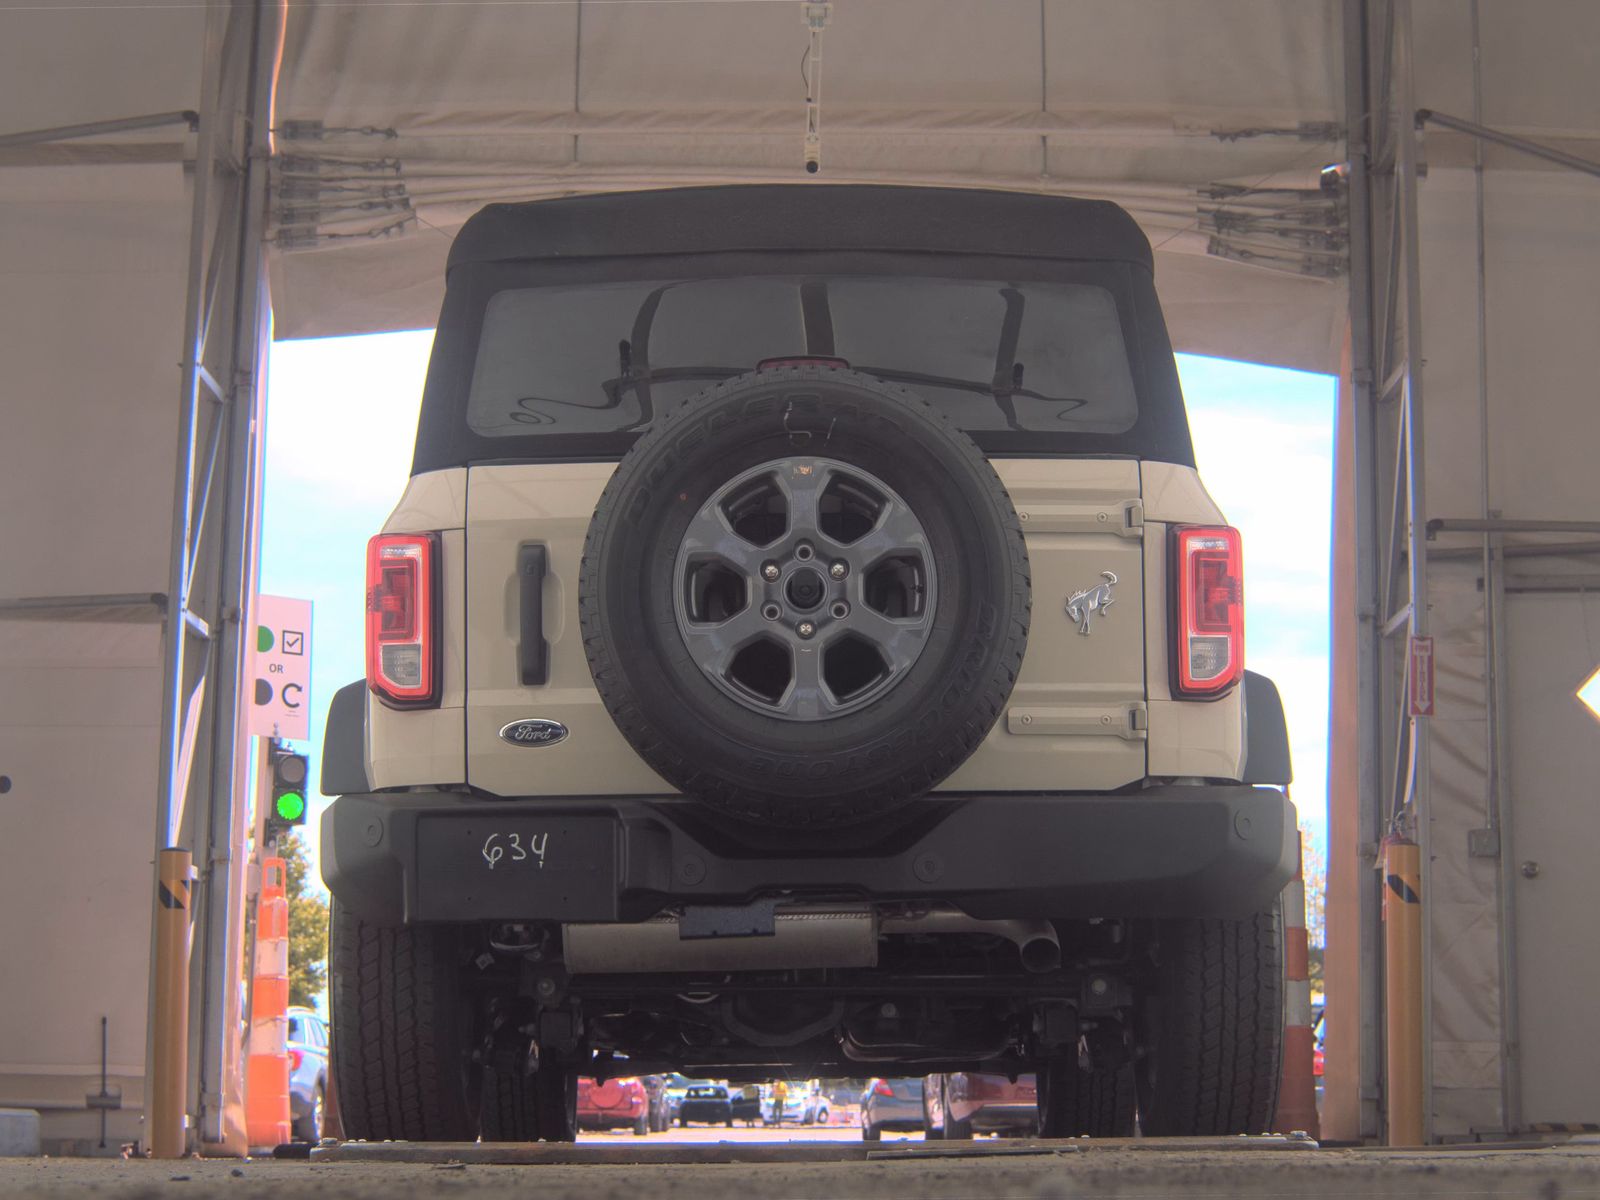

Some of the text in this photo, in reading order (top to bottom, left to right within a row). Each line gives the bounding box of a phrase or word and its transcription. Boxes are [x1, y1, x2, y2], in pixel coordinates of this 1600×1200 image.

[268, 663, 284, 674] OR
[514, 724, 552, 741] Ford
[482, 832, 549, 869] 634
